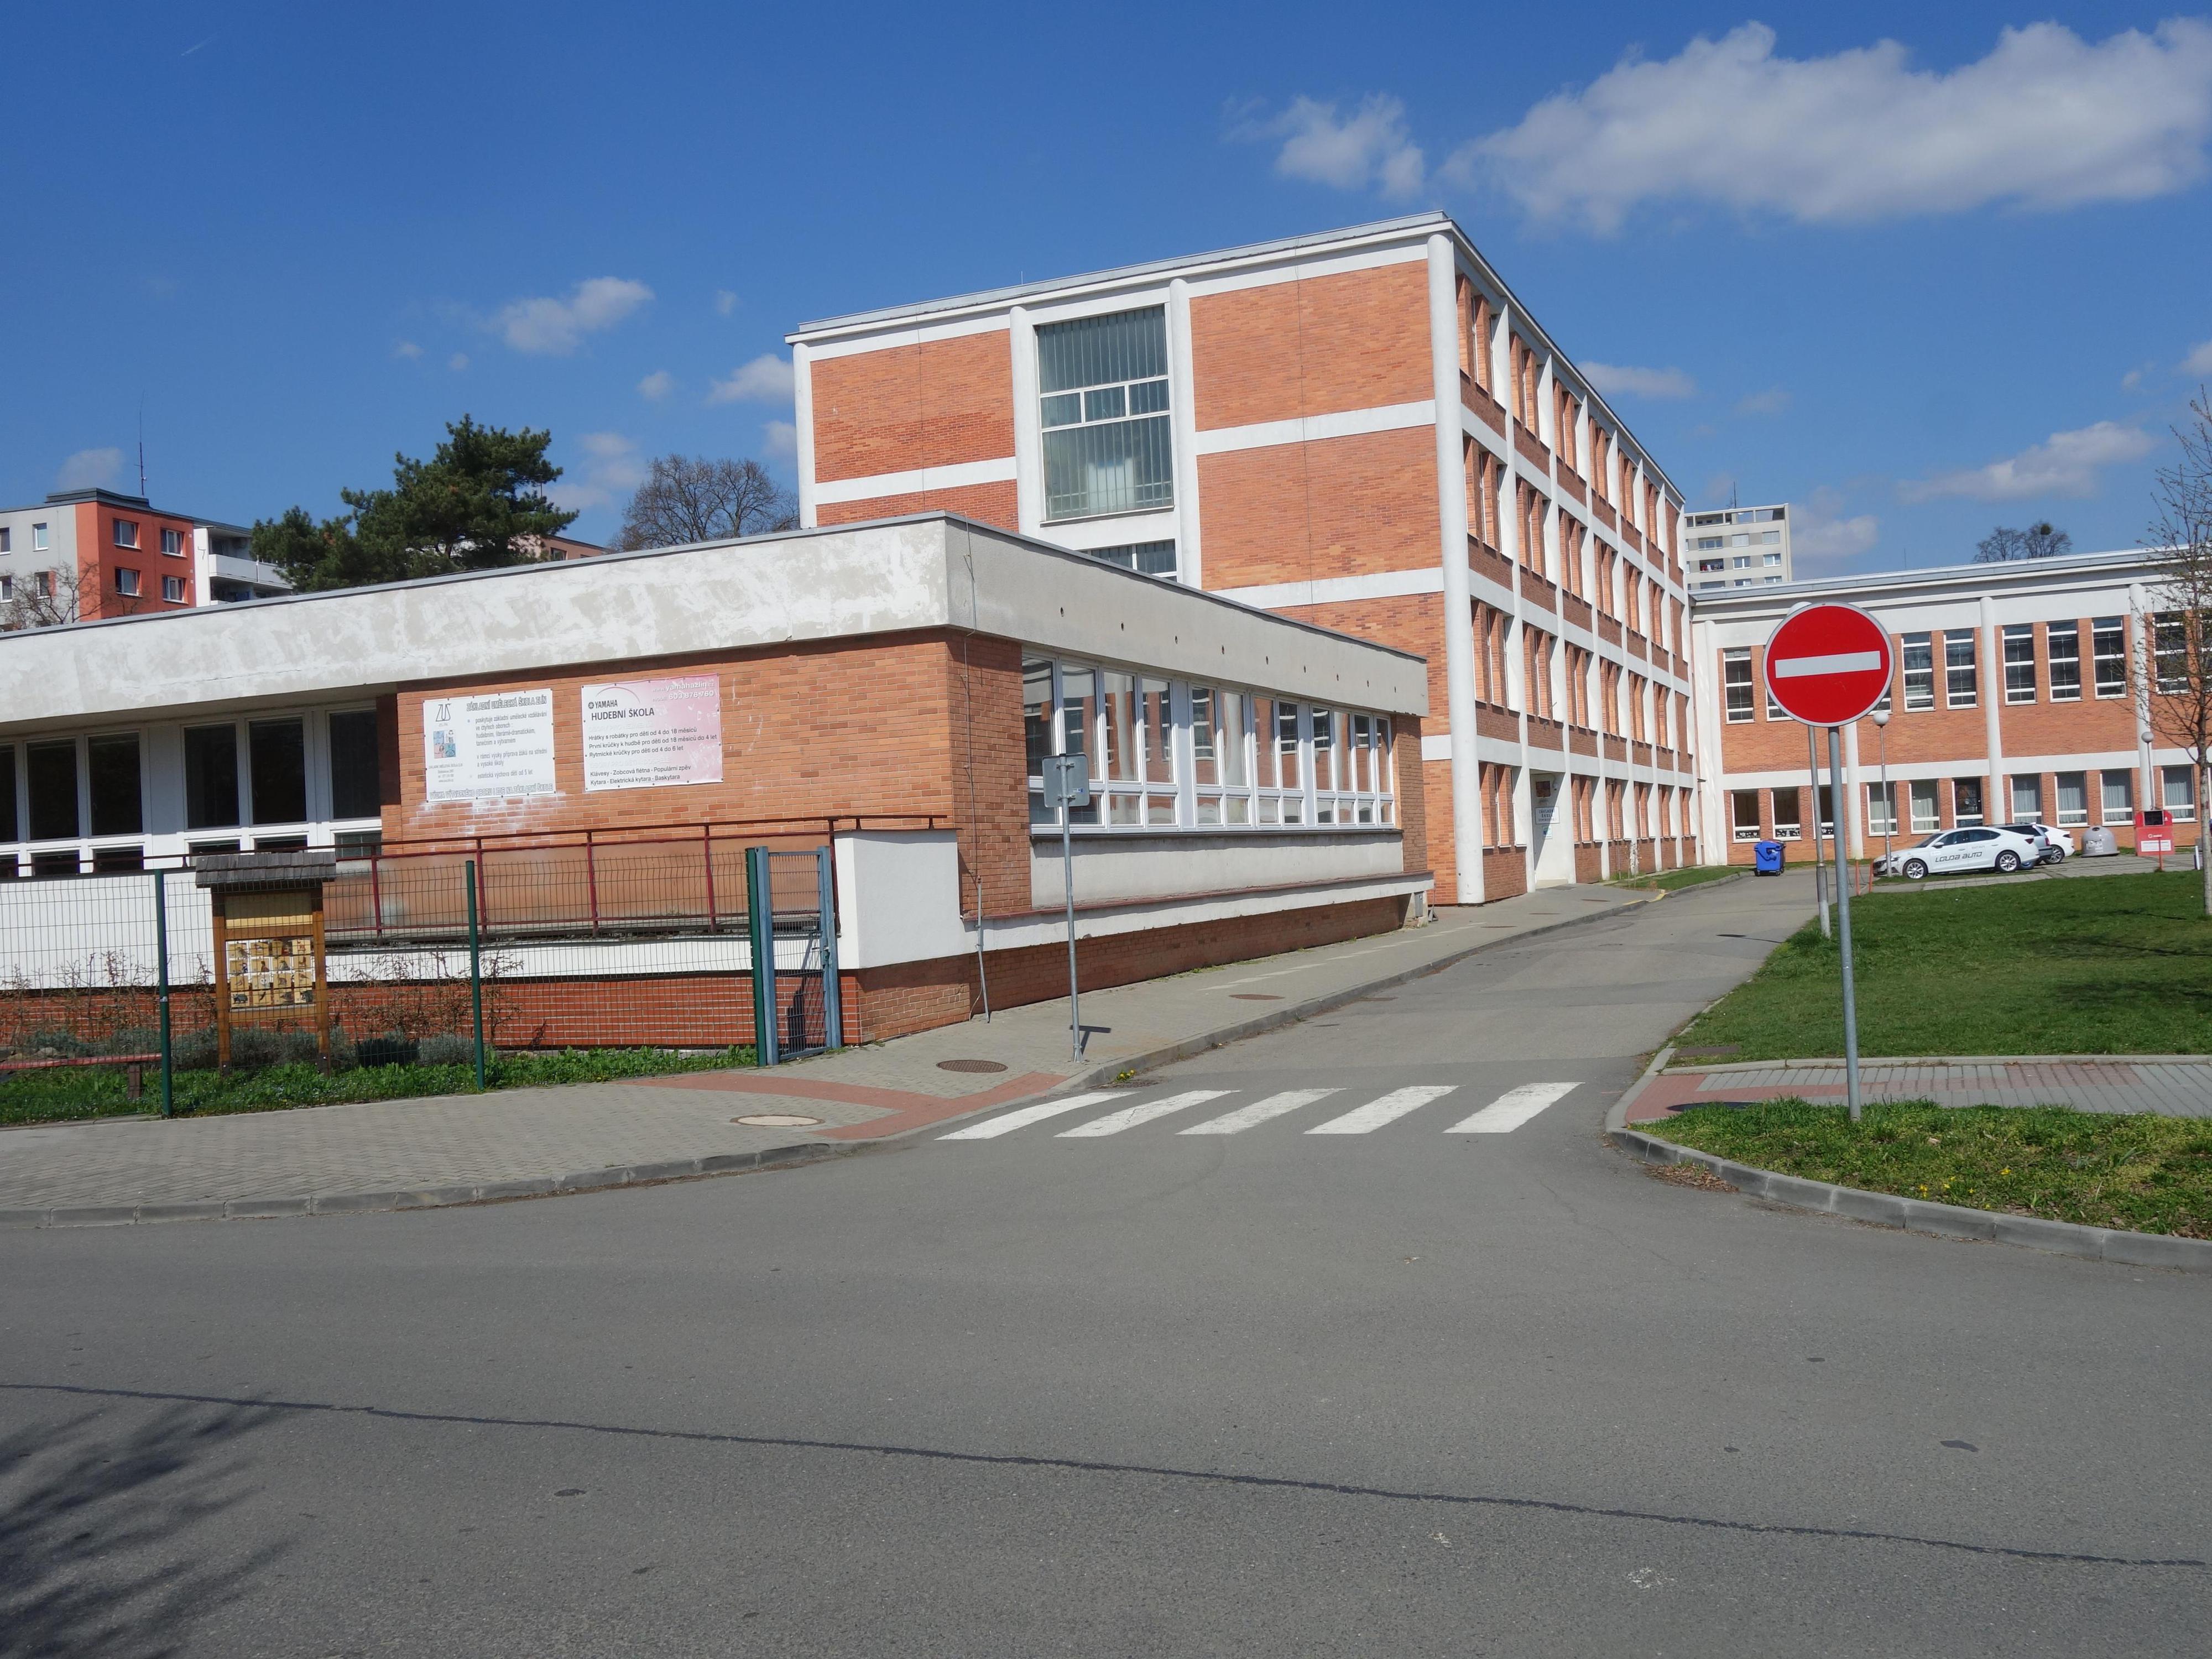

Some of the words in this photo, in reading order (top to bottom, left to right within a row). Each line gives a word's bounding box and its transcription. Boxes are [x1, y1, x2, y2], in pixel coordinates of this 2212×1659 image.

[466, 700, 491, 712] ZÁKLADNÍ
[491, 697, 518, 709] UMĚLECKÁ
[518, 696, 535, 706] ŠKOLA
[535, 694, 547, 705] ZLÍN
[594, 700, 618, 708] YAMAHA
[591, 708, 626, 721] HUDEBNÍ
[628, 707, 655, 718] ŠKOLA
[537, 782, 553, 792] ŠKOLE
